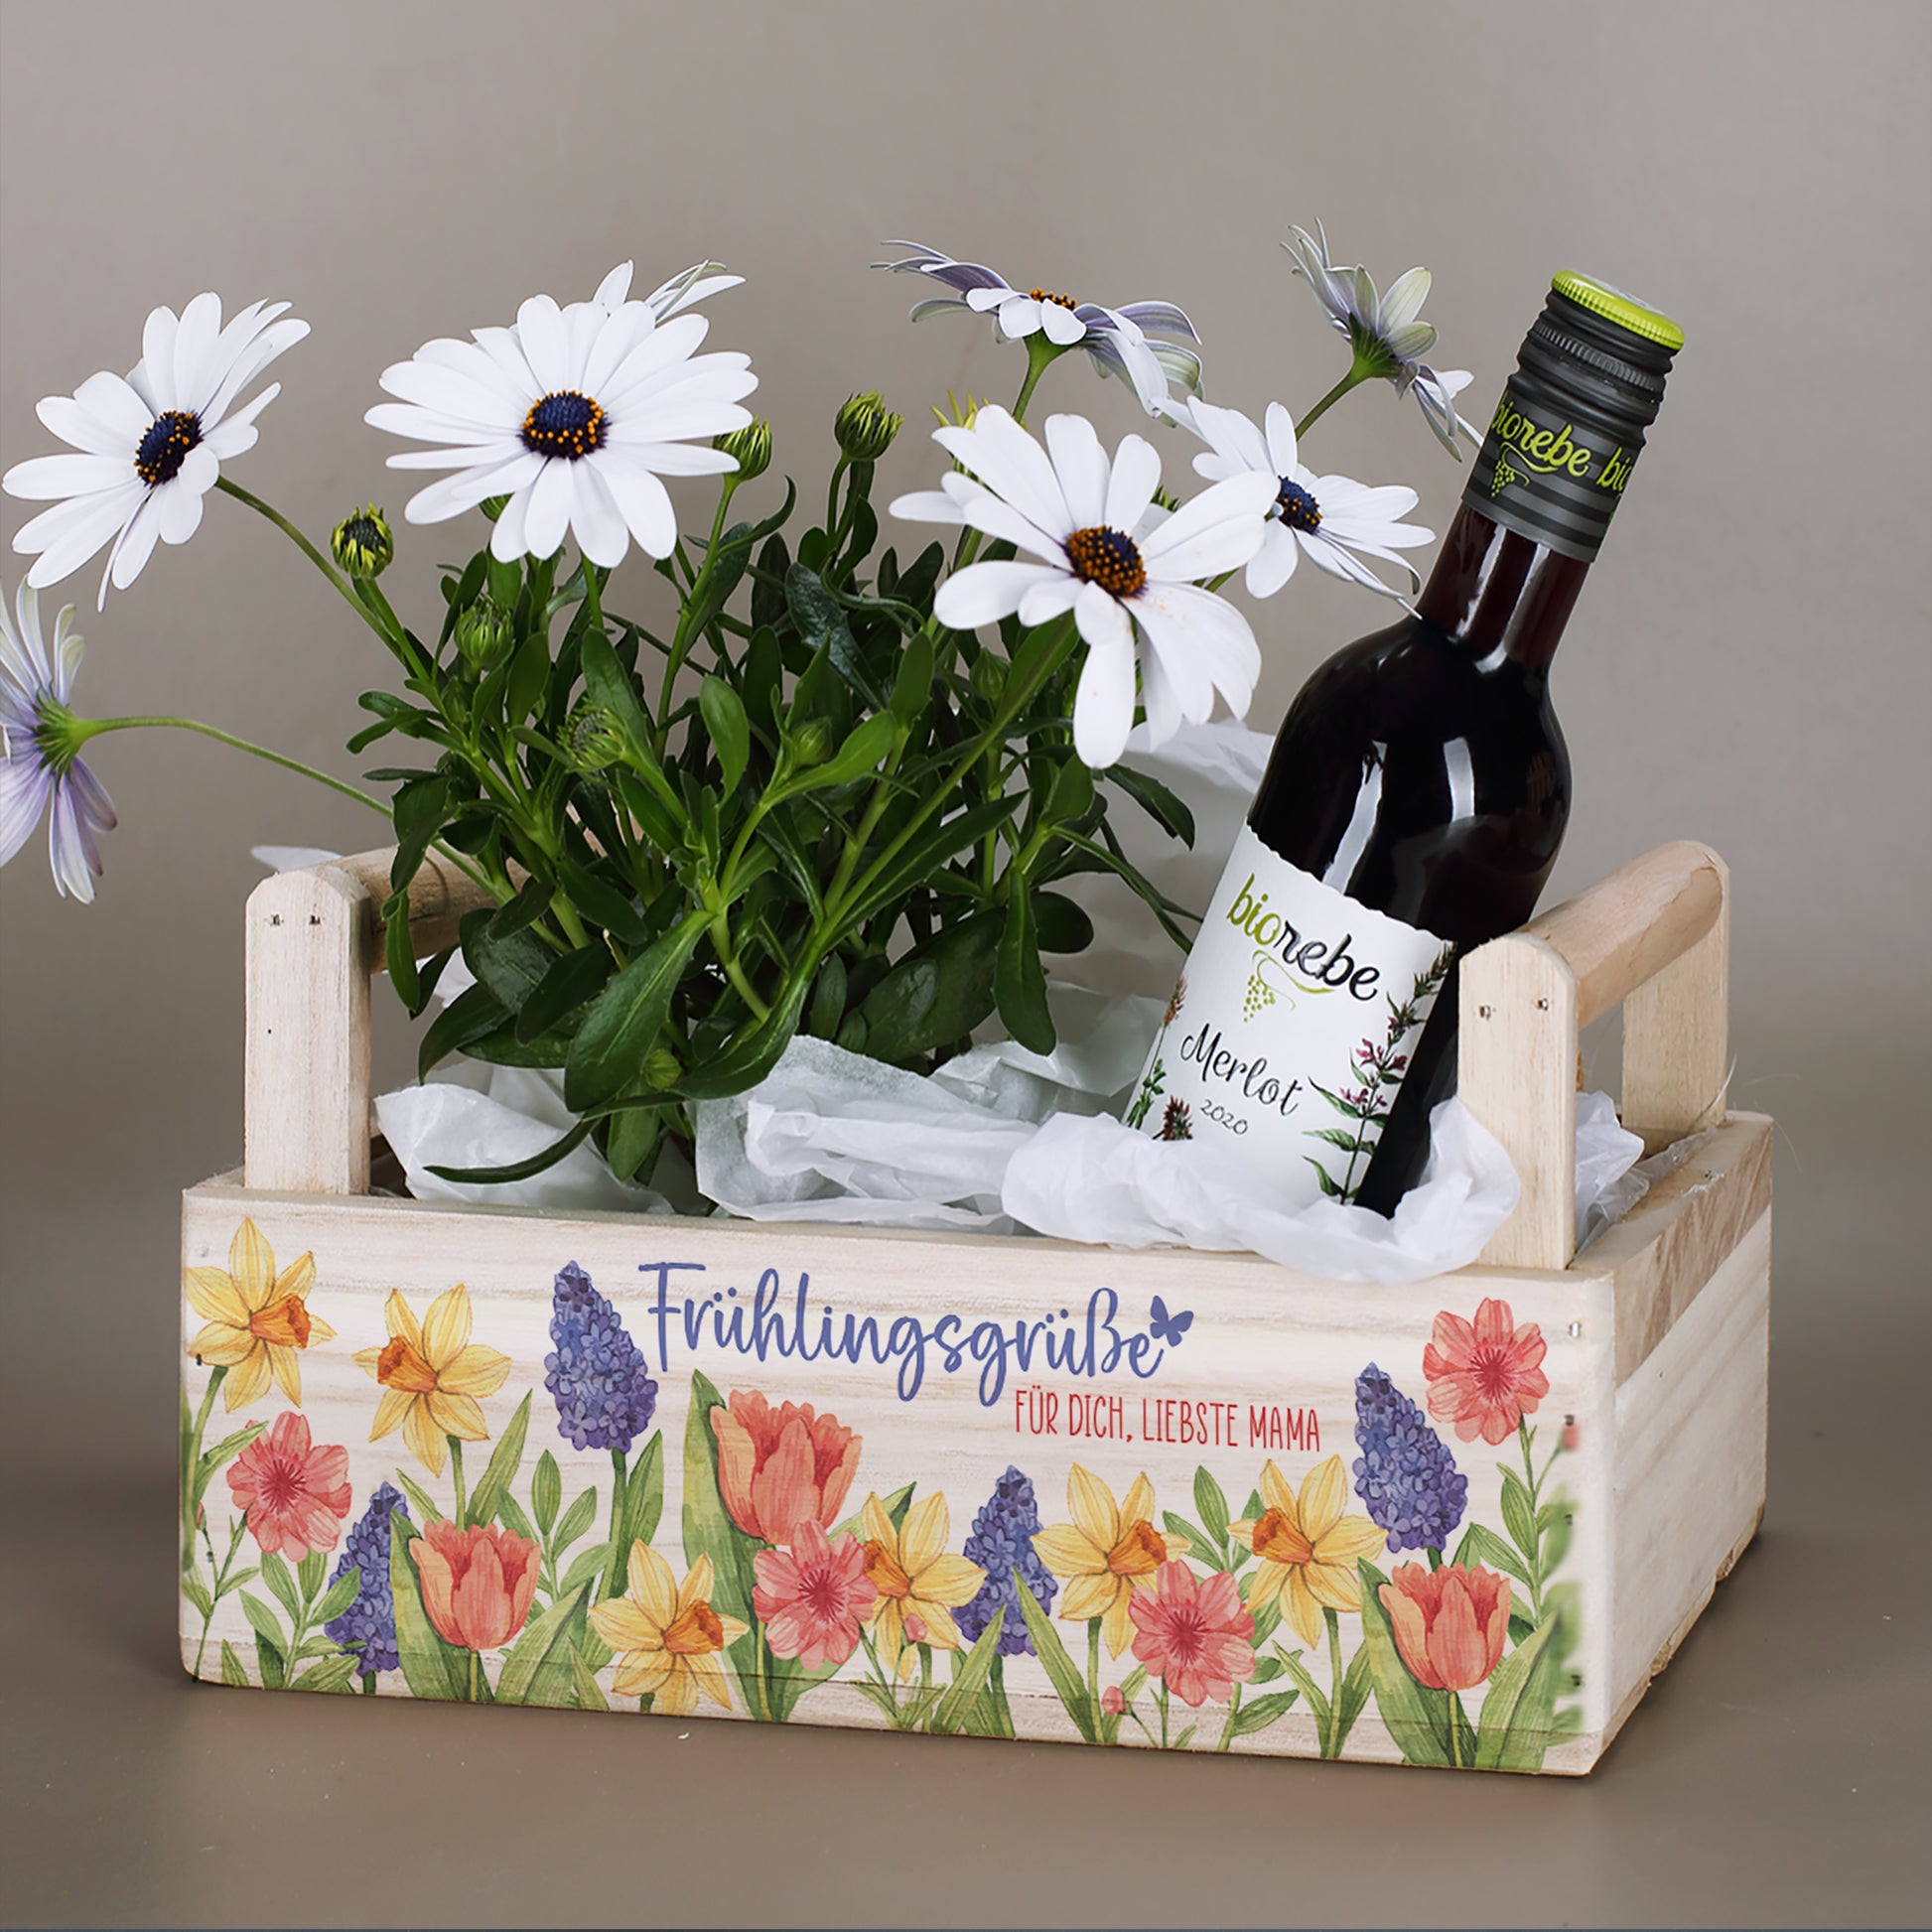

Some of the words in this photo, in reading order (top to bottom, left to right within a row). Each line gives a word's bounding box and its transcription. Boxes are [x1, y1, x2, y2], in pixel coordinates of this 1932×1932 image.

[1491, 391, 1590, 477] biorebe
[1227, 874, 1380, 1001] biorebe
[1180, 1023, 1303, 1116] Merlot
[1200, 1099, 1248, 1135] 2020
[638, 1262, 1165, 1407] Frühlingsgrüße
[1015, 1386, 1058, 1436] FÜR
[1068, 1394, 1134, 1443] DICH,
[1143, 1398, 1239, 1448] LIEBSTE
[1249, 1405, 1320, 1452] MAMA
